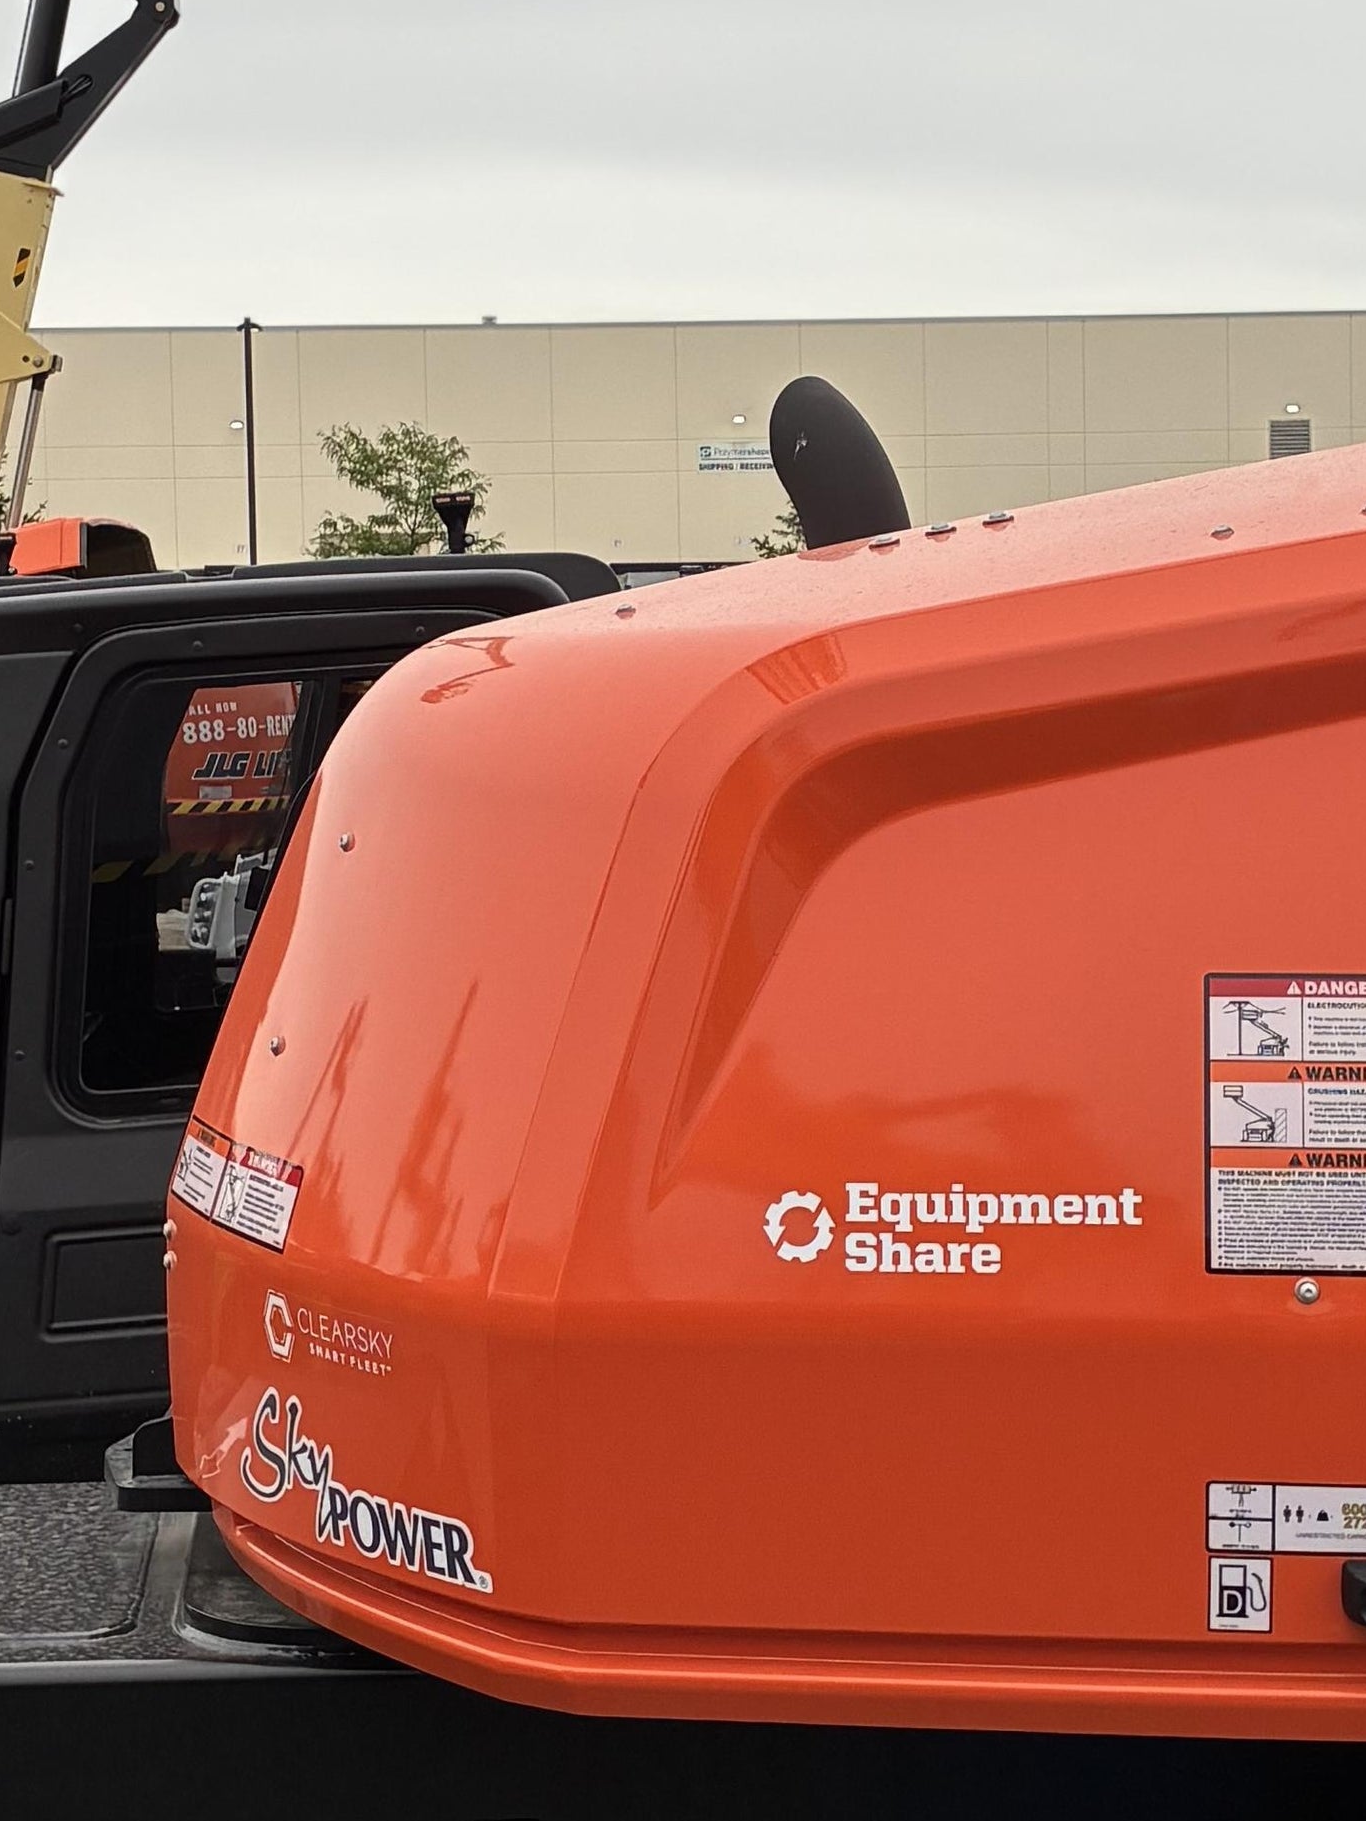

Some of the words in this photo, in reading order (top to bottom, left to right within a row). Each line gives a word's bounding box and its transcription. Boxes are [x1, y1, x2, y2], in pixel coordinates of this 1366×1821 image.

[191, 750, 252, 780] JLG
[845, 1182, 1143, 1234] Equipment
[845, 1232, 1002, 1274] Share
[297, 1307, 393, 1359] CLEARSKY
[308, 1342, 346, 1366] SMART
[241, 1390, 334, 1541] Sky
[327, 1485, 477, 1586] POWER
